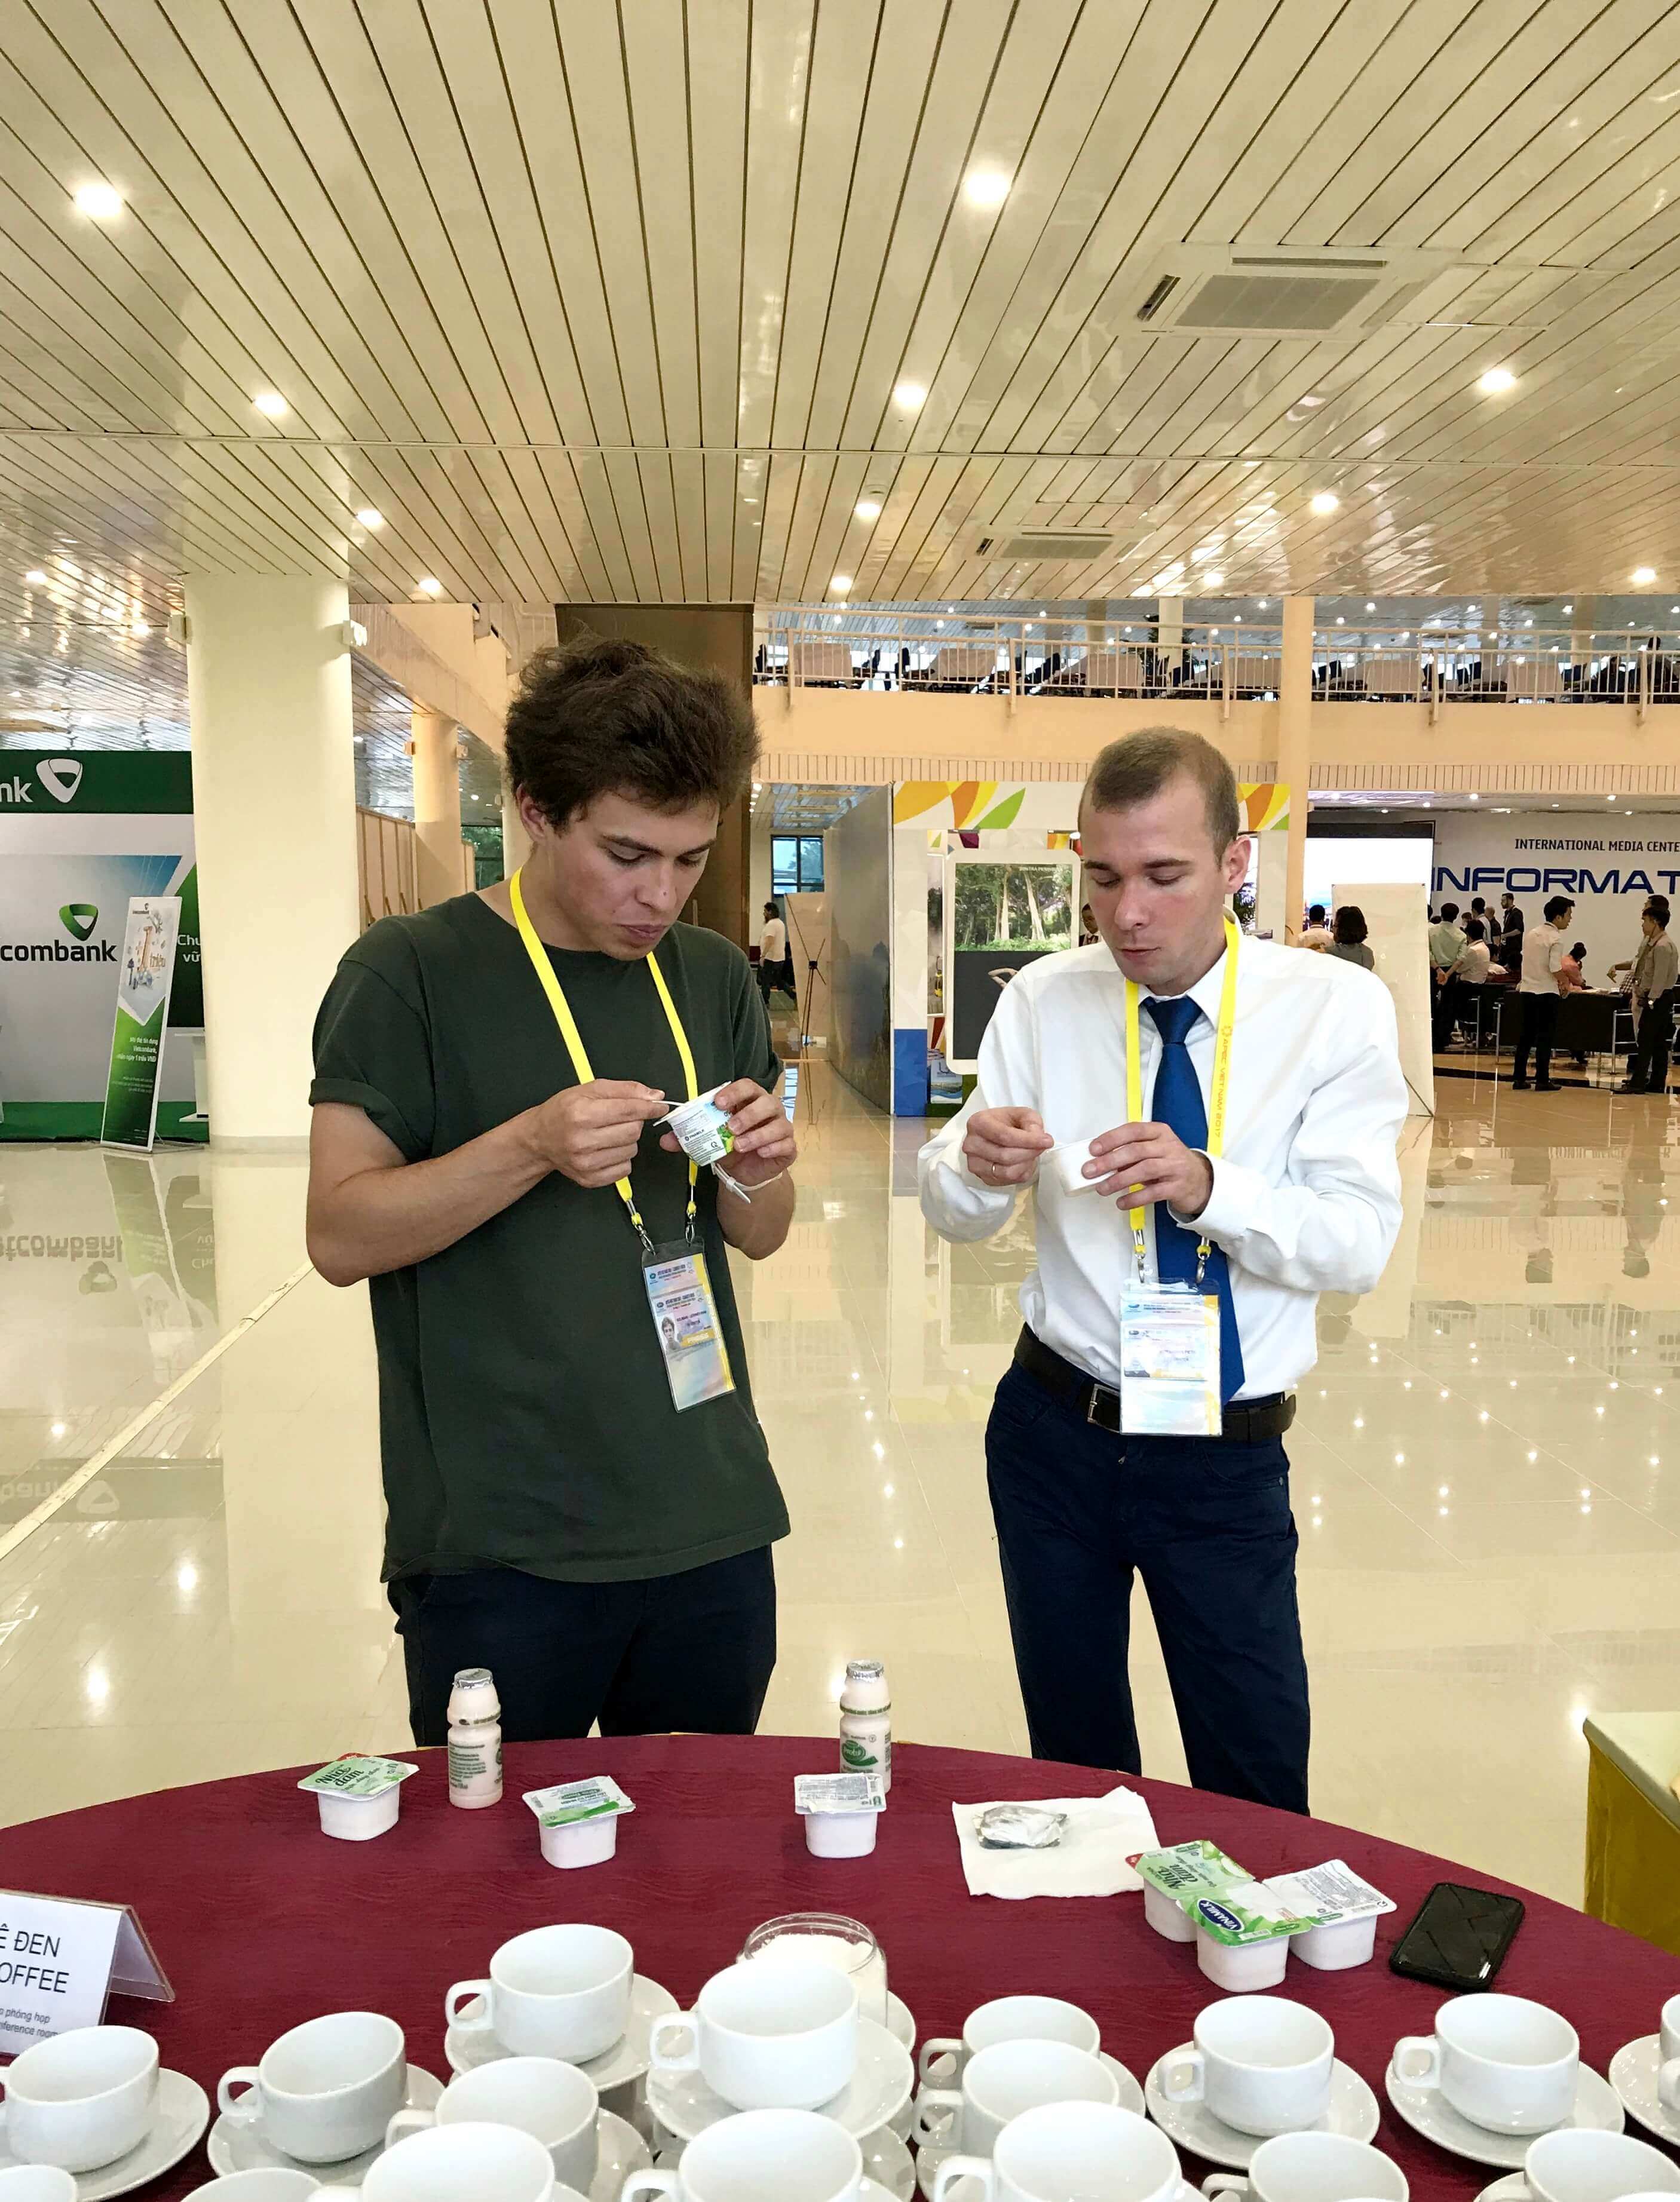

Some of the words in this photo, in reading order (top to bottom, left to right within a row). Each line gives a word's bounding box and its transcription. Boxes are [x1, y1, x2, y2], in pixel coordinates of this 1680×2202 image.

[1515, 839, 1605, 851] INTERNATIONAL
[1608, 841, 1644, 851] MEDIA
[1647, 842, 1679, 852] CENTE
[1, 940, 118, 962] combank
[1200, 1901, 1238, 1930] VINAMILK
[13, 1930, 60, 1958] ĐEN
[0, 1962, 69, 1994] OFFEE
